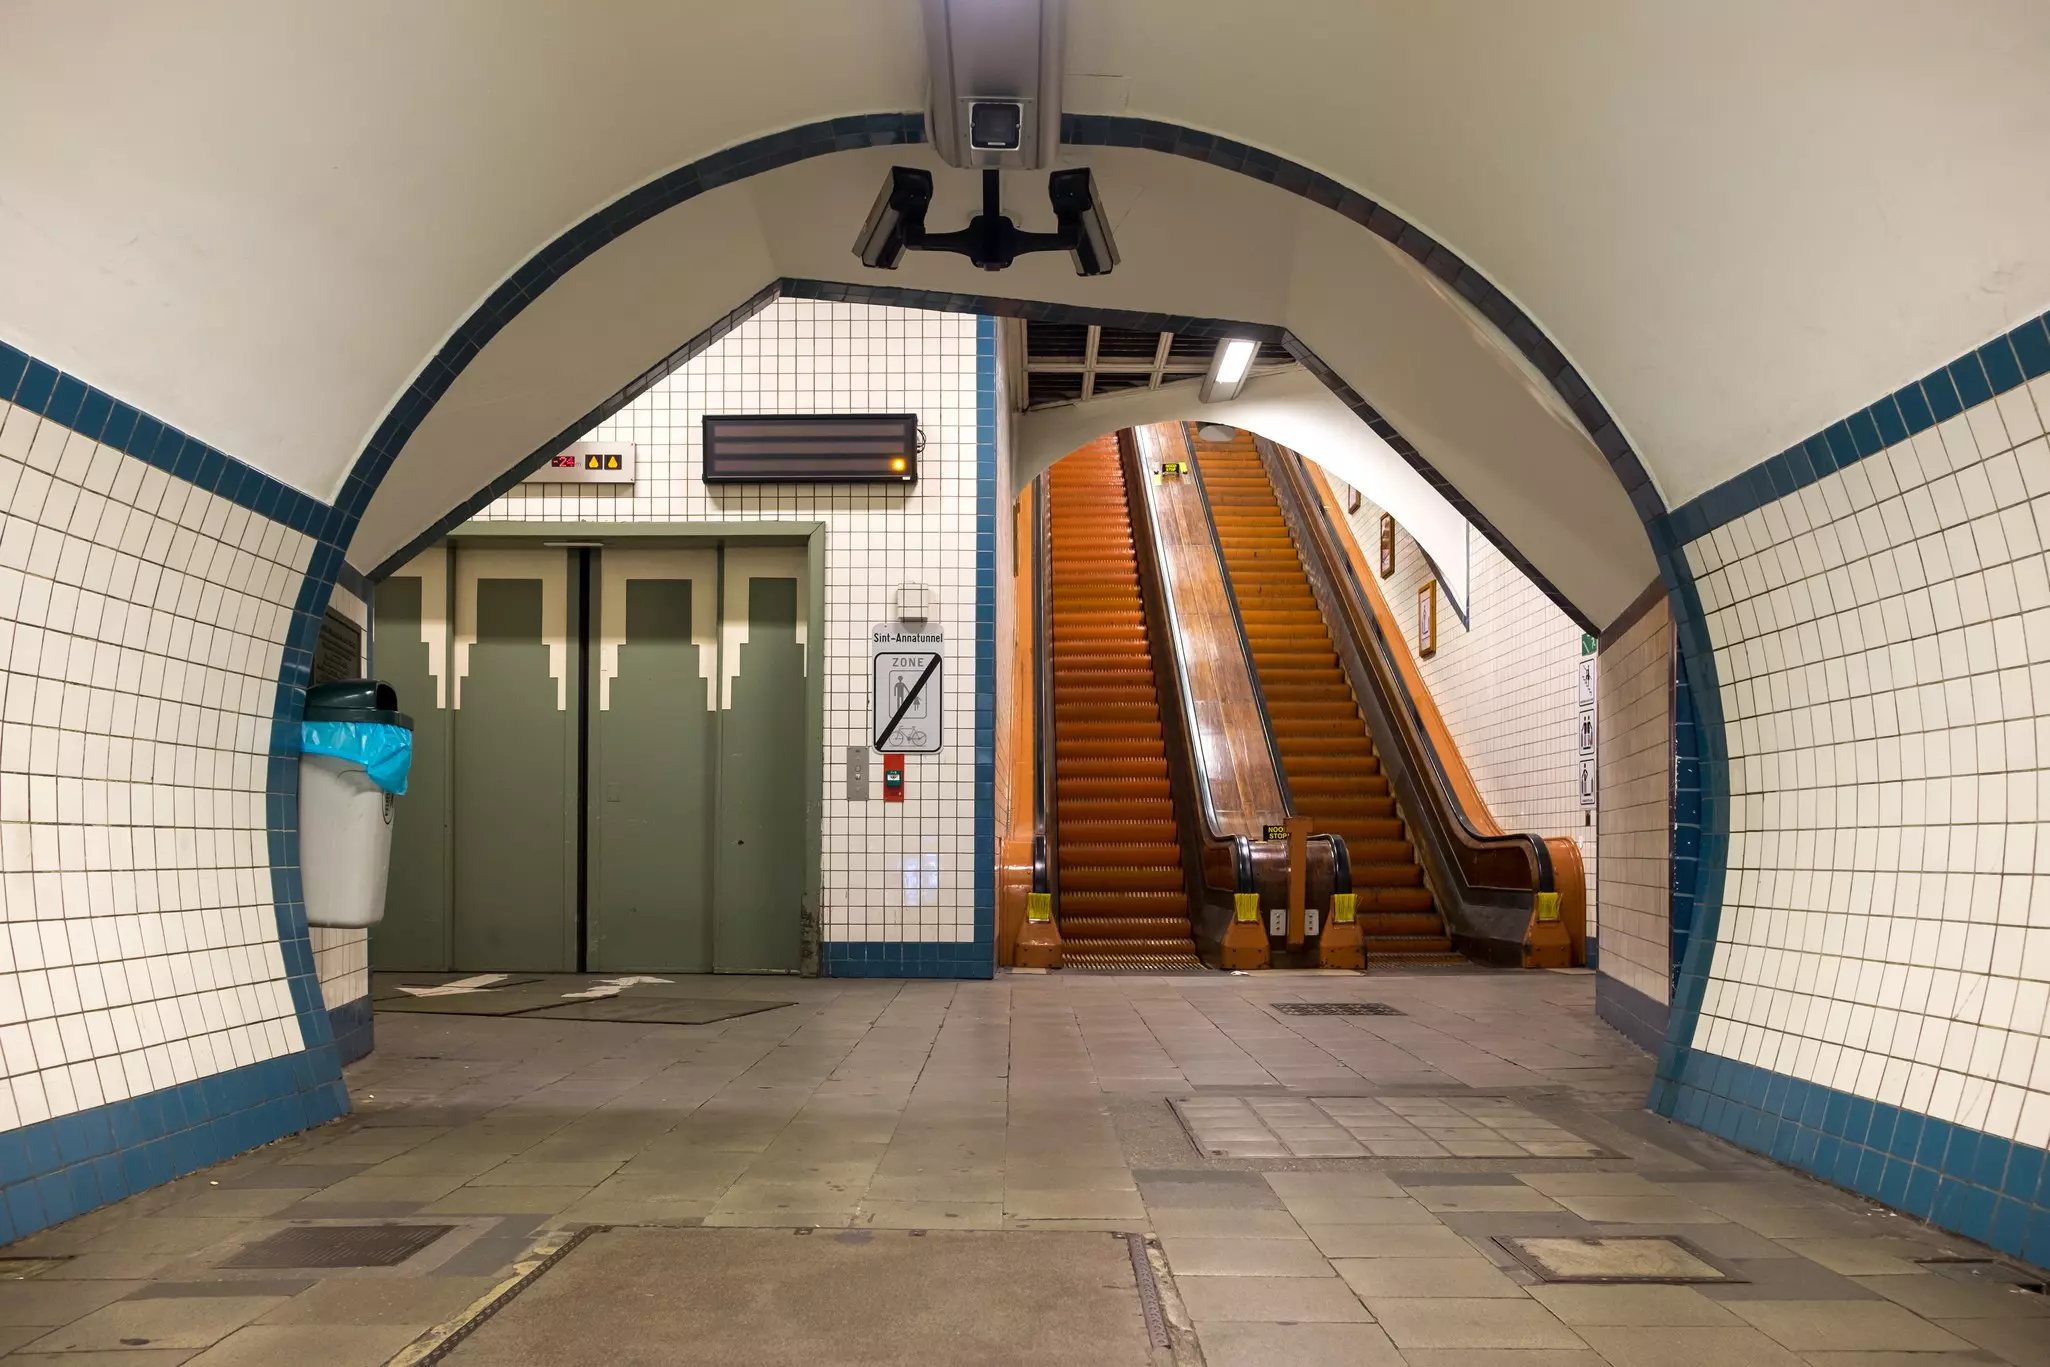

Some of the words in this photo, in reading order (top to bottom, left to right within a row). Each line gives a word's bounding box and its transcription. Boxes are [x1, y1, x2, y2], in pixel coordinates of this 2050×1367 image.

[553, 456, 574, 467] -24
[873, 632, 943, 643] Sint-Annatunnel
[892, 657, 925, 667] ZONE
